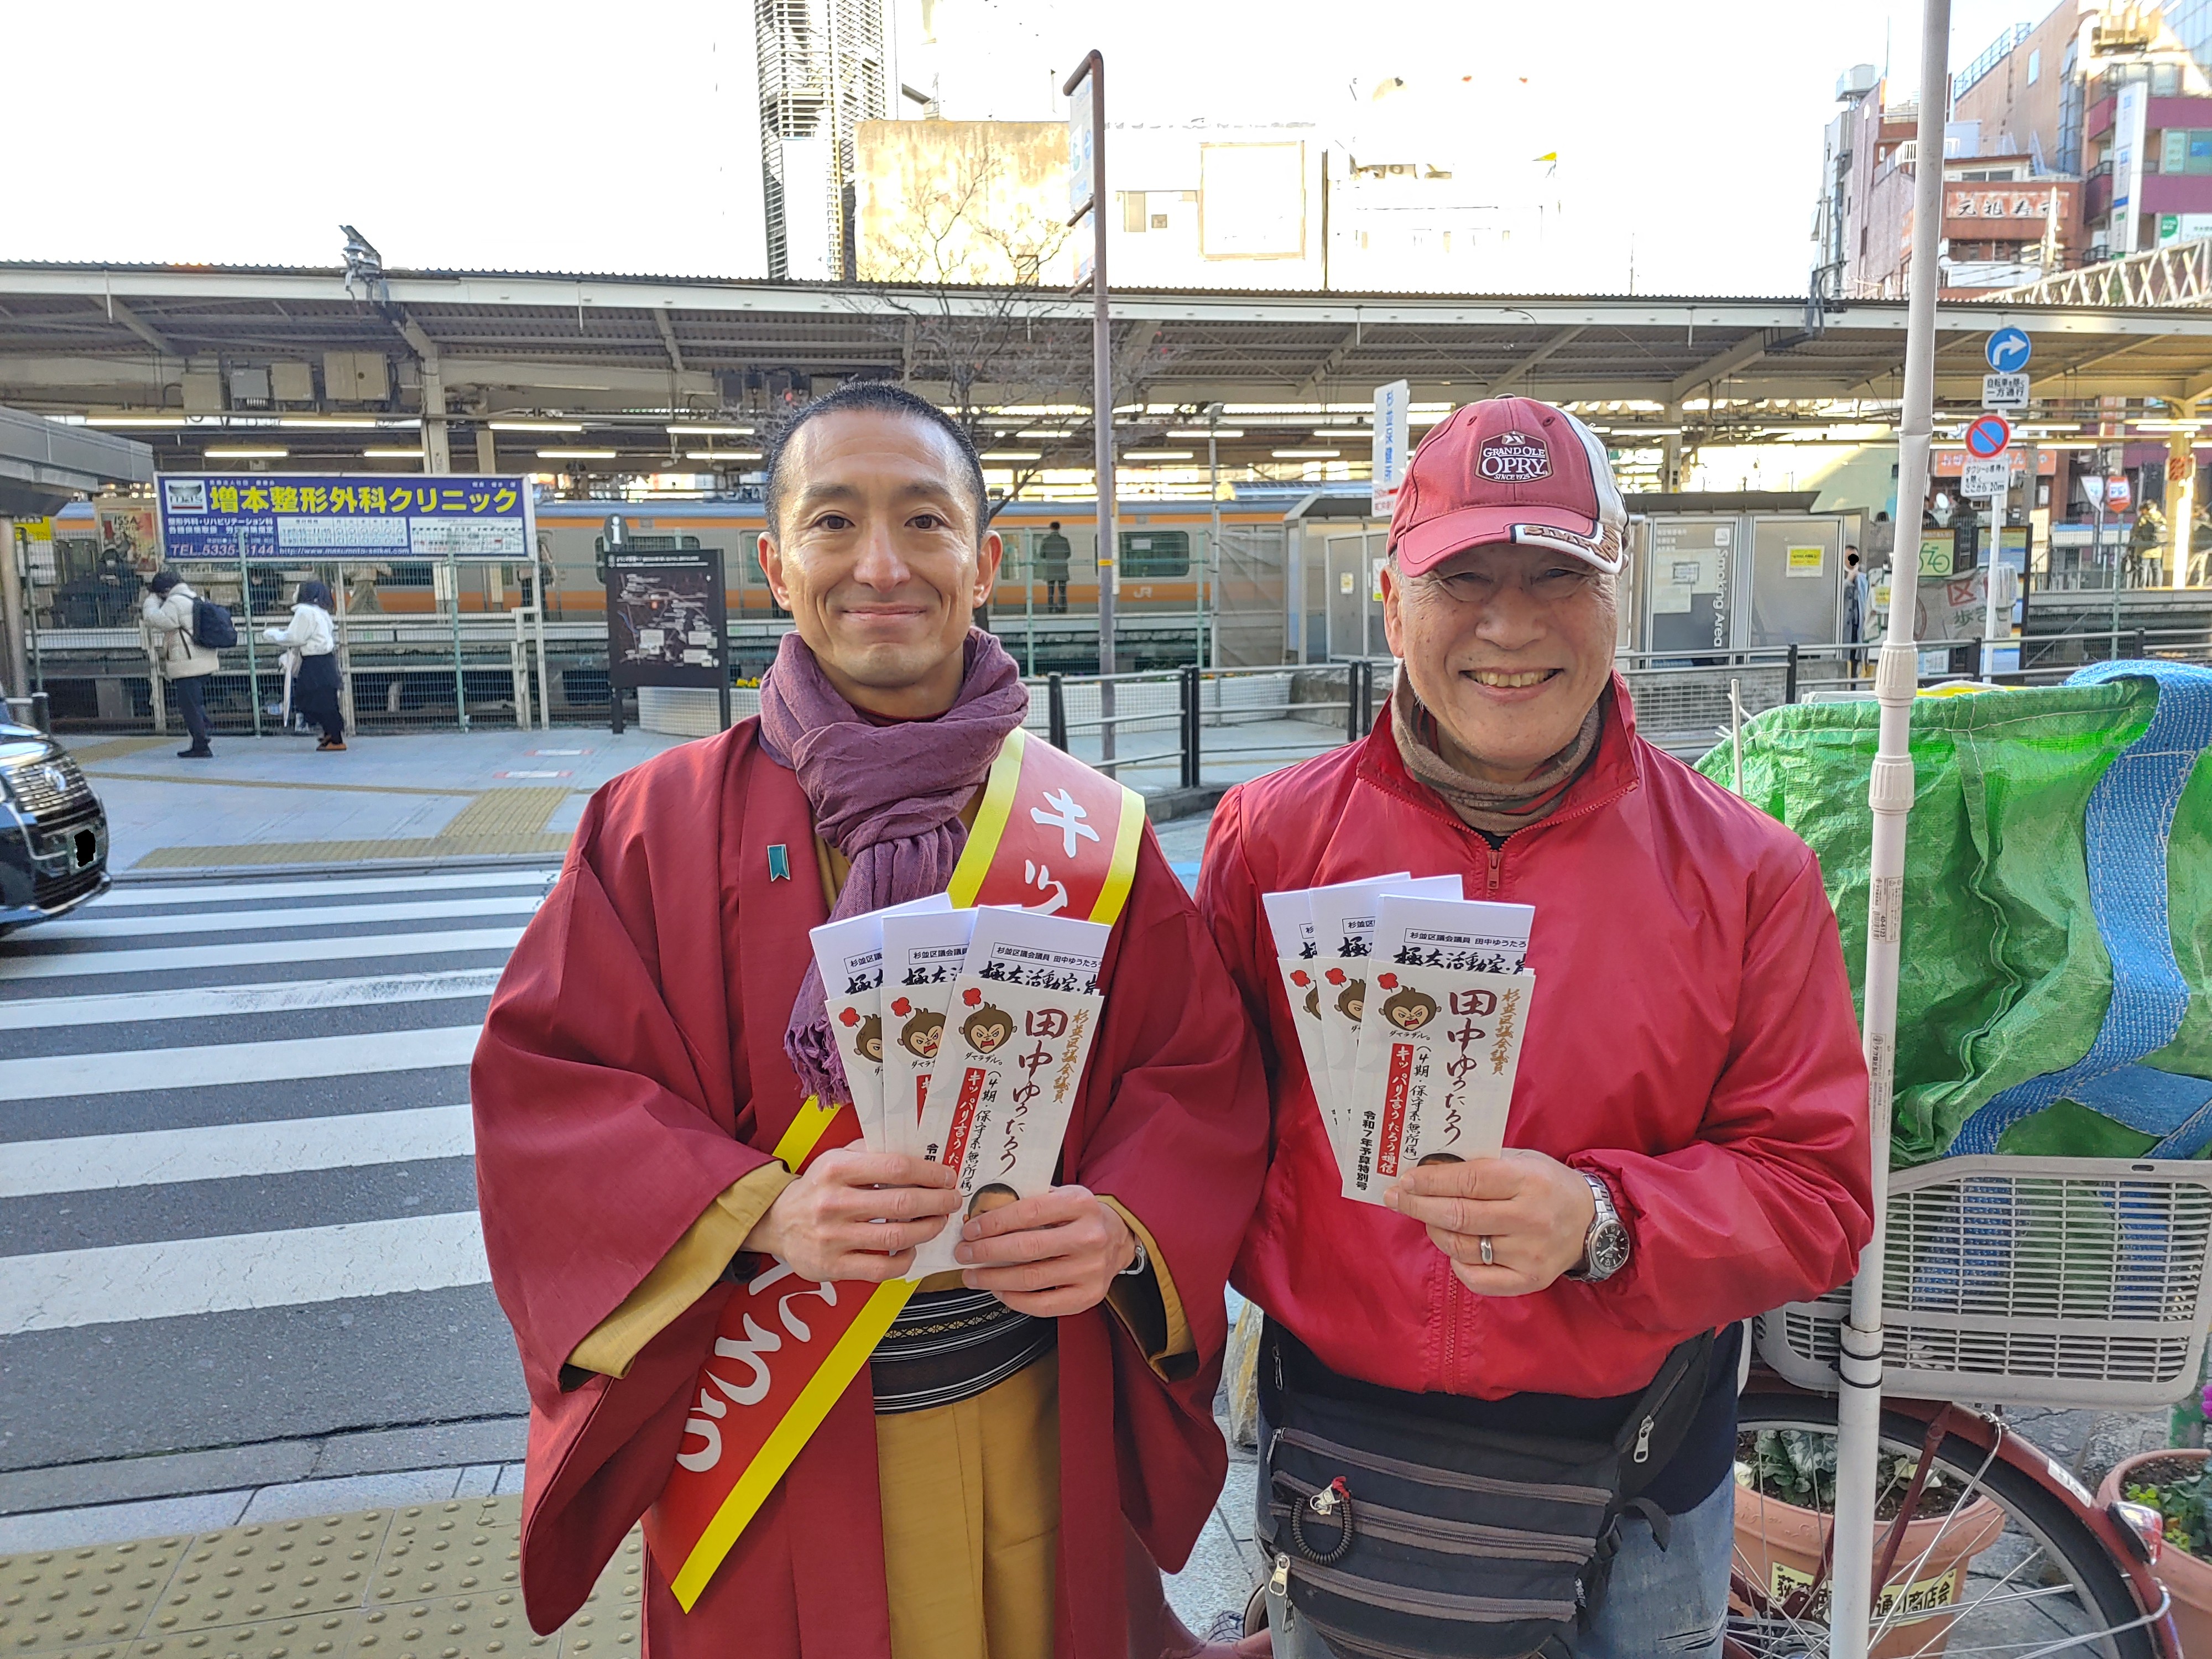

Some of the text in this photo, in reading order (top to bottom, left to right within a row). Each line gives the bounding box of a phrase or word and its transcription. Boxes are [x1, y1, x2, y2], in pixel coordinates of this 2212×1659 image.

[1987, 378, 2025, 388] 自転車を除く
[1987, 388, 2024, 398] 一方通行
[1483, 446, 1545, 457] GRAND OLE
[1482, 456, 1547, 477] OPRY
[210, 486, 517, 514] 増本整形外科クリニック
[170, 544, 274, 556] TEL.5335-144
[1134, 586, 1152, 598] JR
[1713, 550, 1728, 647] Smoking Area
[1348, 920, 1375, 928] 杉並区
[1410, 932, 1470, 943] 杉並区議会議員
[997, 947, 1050, 961] 杉並区議会議員
[1489, 988, 1520, 1076] 杉並区議会議員
[1051, 1008, 1091, 1104] 杉並区議会議員
[1443, 988, 1498, 1150] 田中ゆうたろう
[1000, 1009, 1069, 1178] 田中ゆうたろう
[948, 1070, 982, 1168] キッパリ言うた
[1379, 1046, 1412, 1174] キッパリ言うたろう通信
[1355, 1110, 1376, 1191] 令和7年予算特別号
